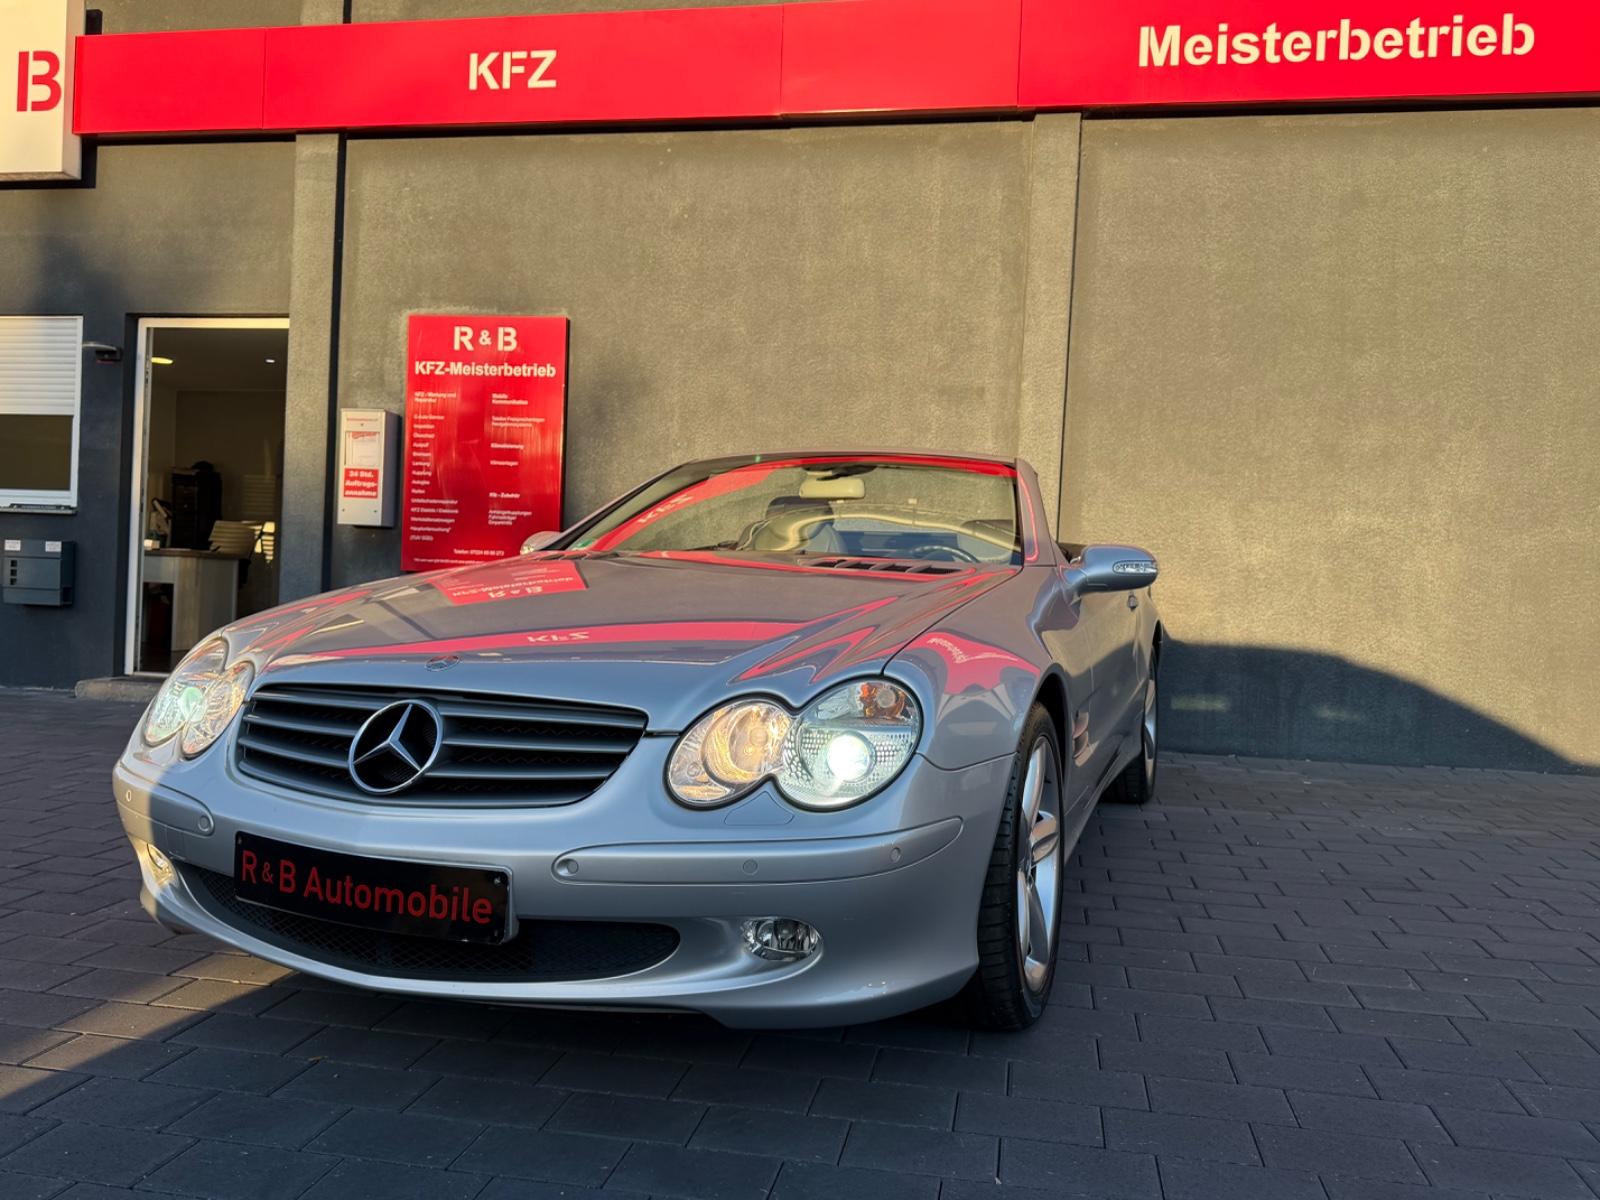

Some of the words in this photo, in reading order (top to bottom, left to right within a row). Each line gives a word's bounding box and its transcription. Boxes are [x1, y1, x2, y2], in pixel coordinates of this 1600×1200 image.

[1138, 12, 1535, 68] Meisterbetrieb
[16, 50, 62, 112] B
[468, 49, 557, 91] KFZ
[453, 325, 474, 351] R
[478, 329, 492, 346] &
[497, 326, 518, 351] B
[414, 360, 557, 377] KFZ-Meisterbetrieb
[241, 851, 258, 884] R
[261, 861, 274, 884] &
[279, 859, 296, 894] B
[303, 866, 493, 925] Automobile
